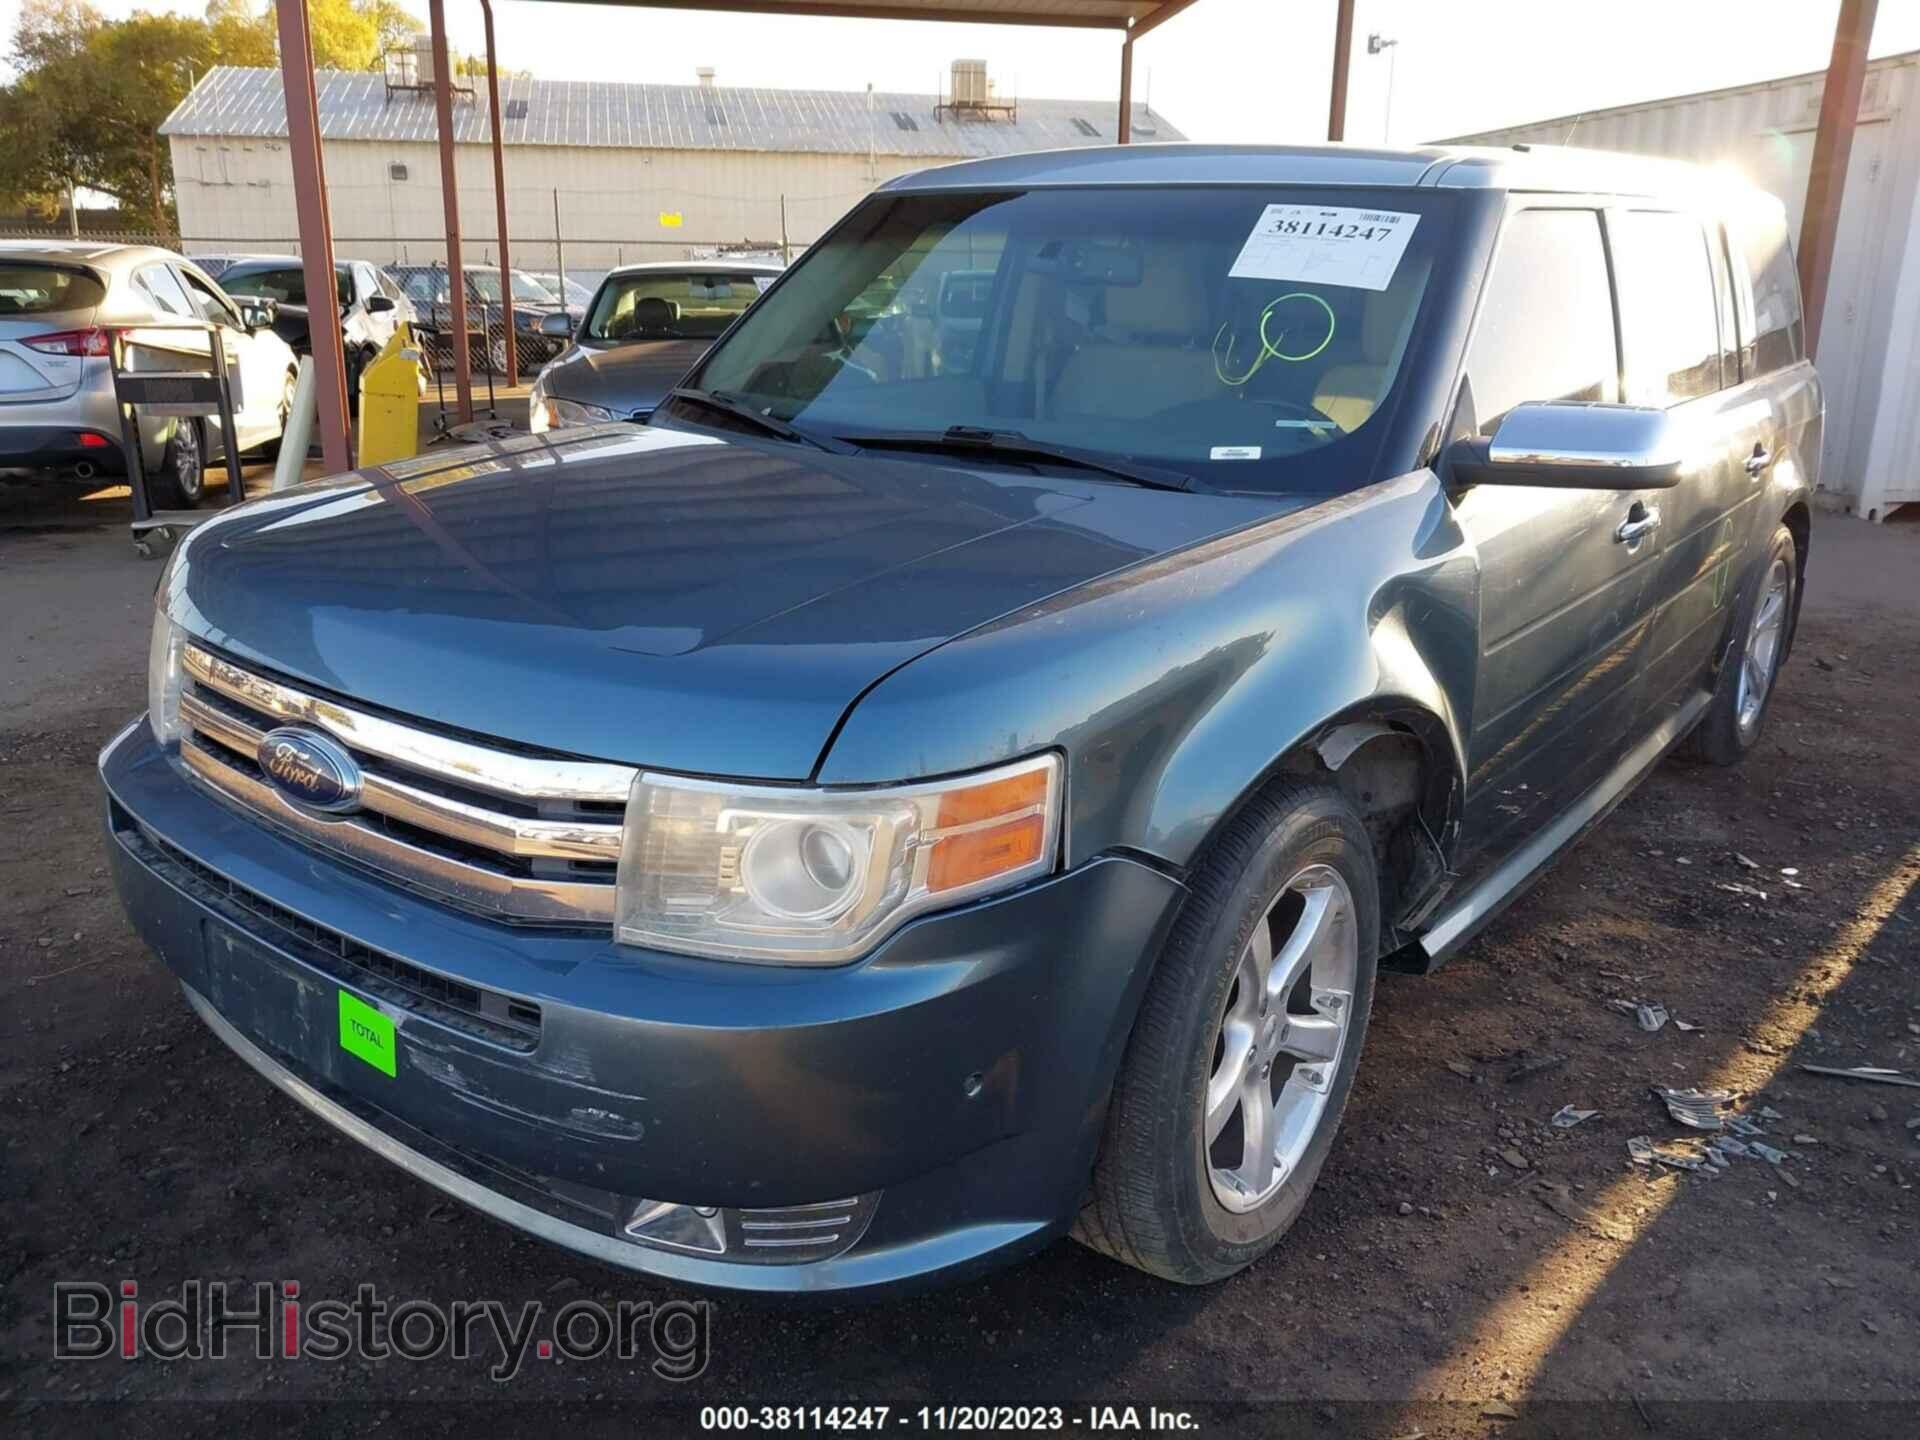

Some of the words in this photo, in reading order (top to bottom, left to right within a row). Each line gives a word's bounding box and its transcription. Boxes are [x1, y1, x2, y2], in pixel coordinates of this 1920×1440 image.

[1268, 219, 1392, 242] 38114247
[269, 742, 322, 792] Ford
[350, 1017, 385, 1050] TOTAL
